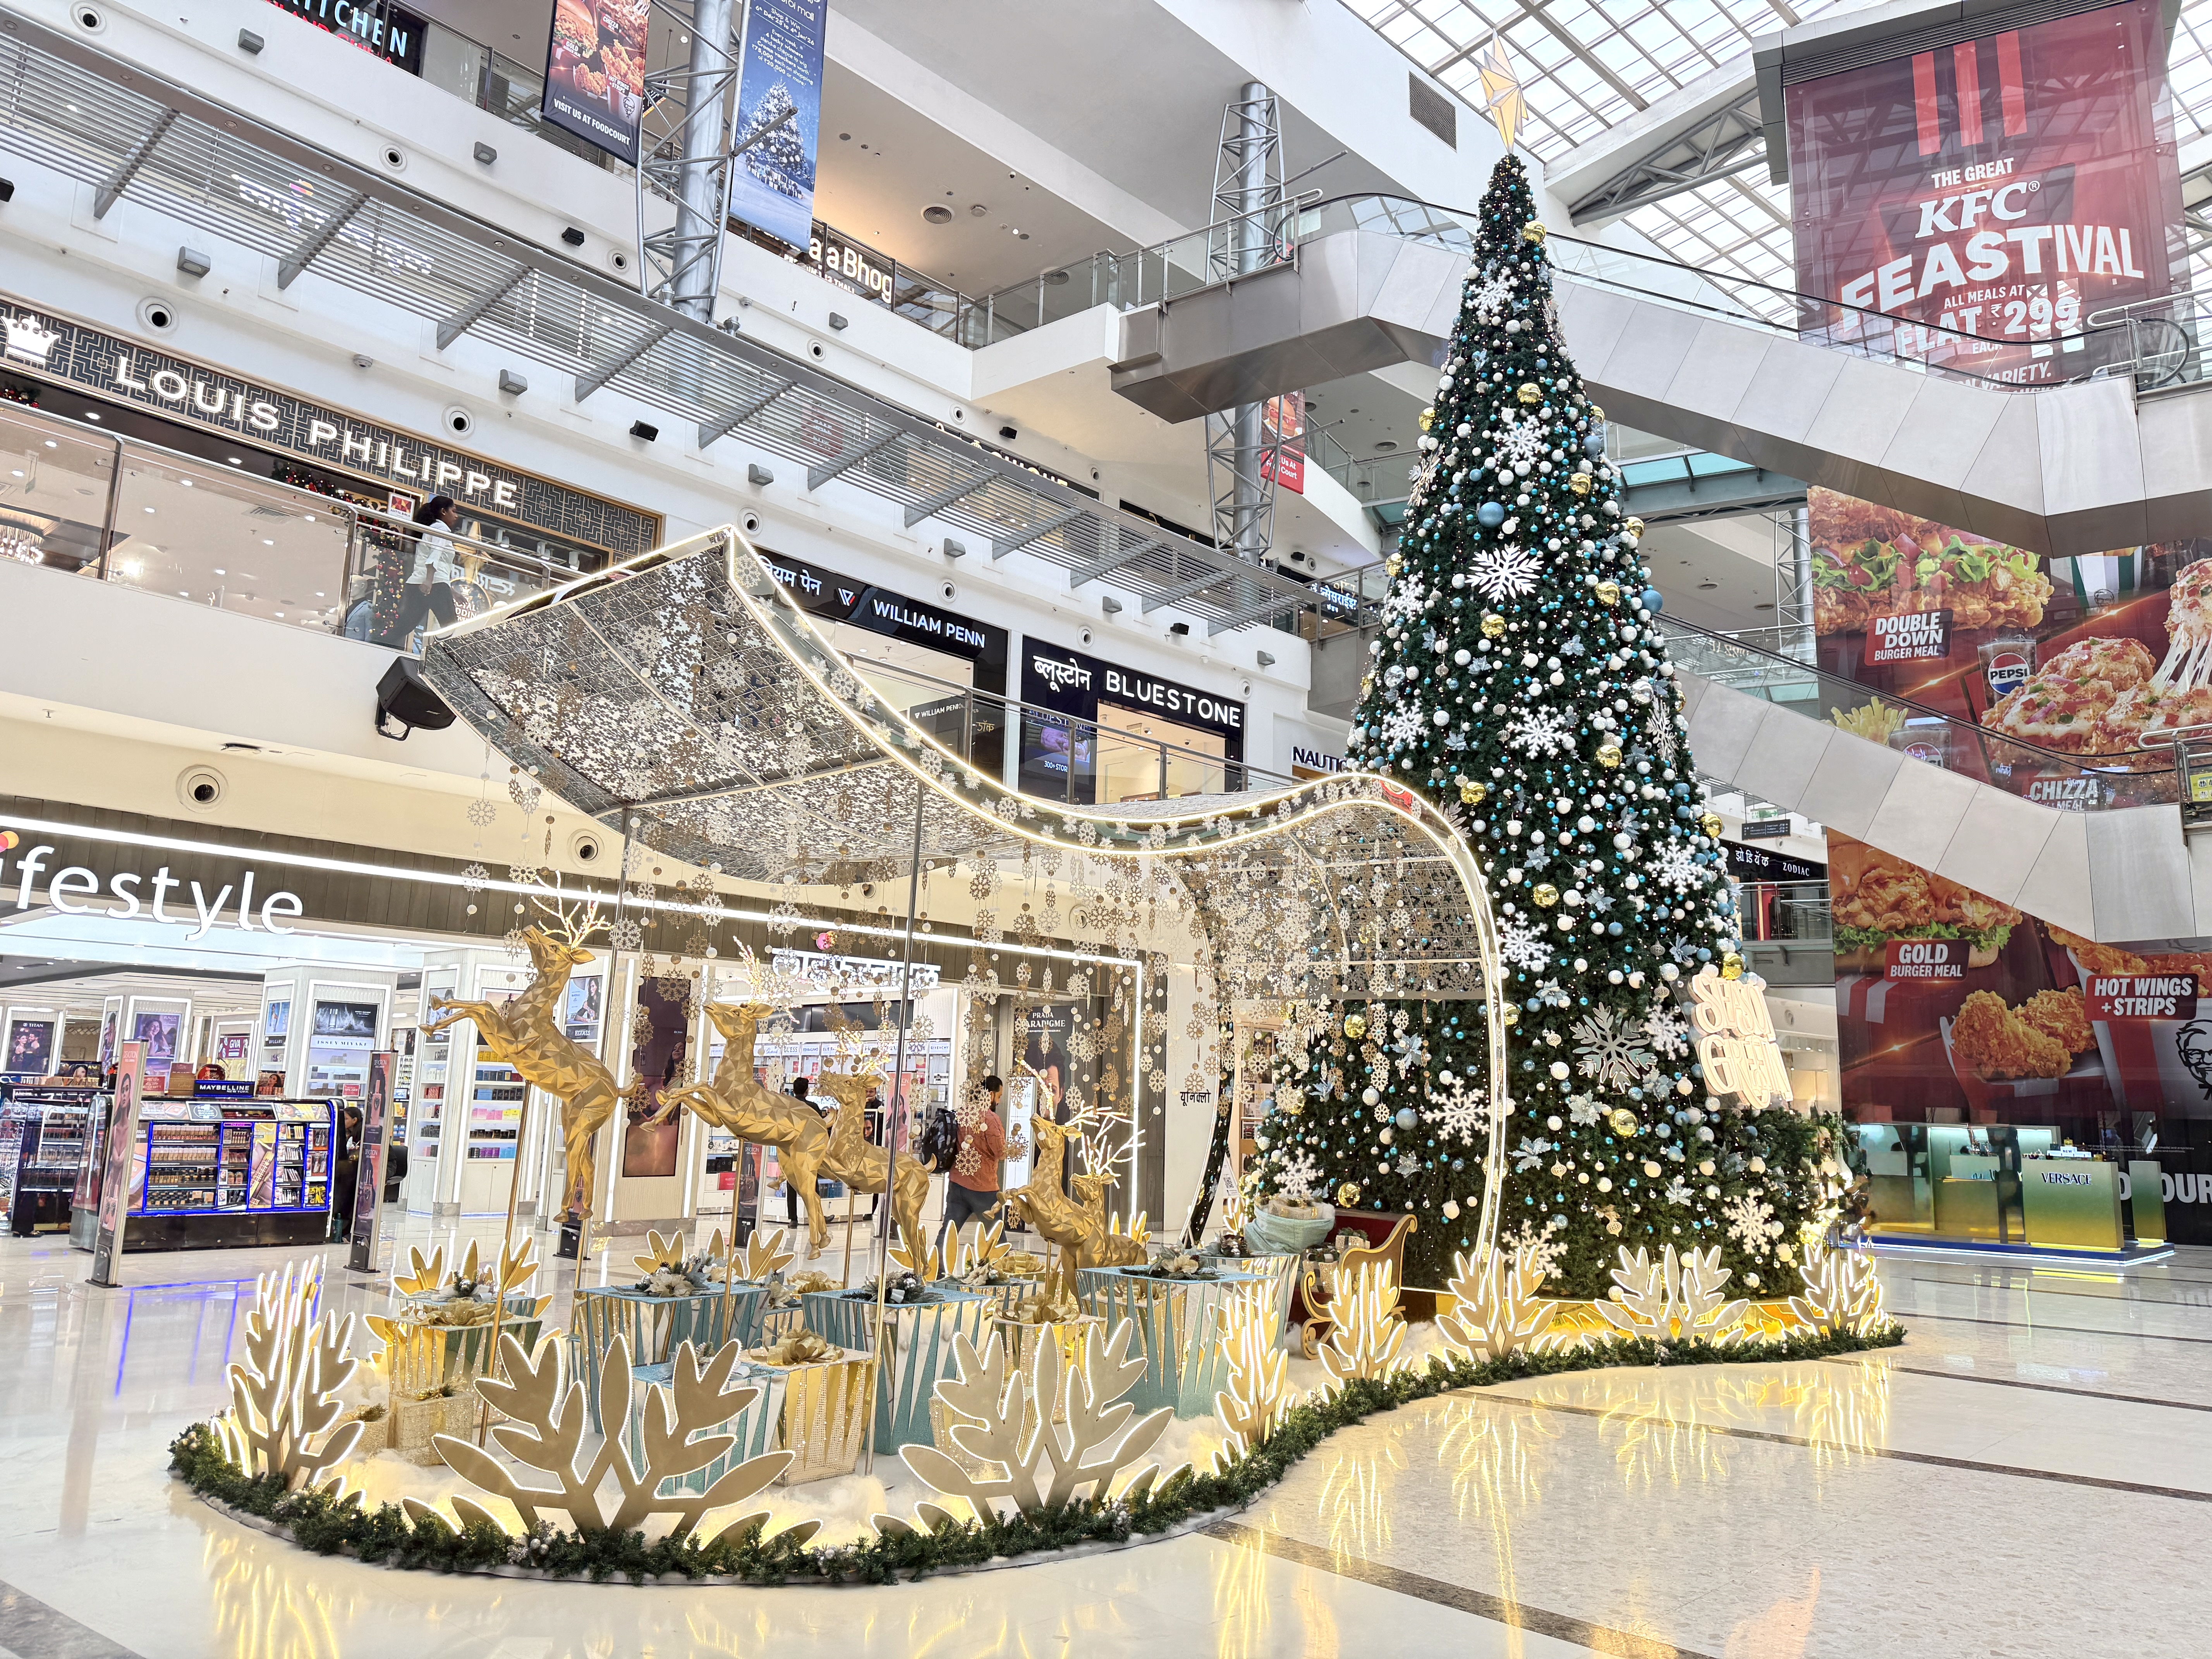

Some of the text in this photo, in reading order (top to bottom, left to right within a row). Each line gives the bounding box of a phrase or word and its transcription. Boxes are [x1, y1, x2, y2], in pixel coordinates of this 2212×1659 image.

[603, 16, 618, 29] CHIZZA
[771, 8, 784, 20] Shop
[790, 20, 801, 31] Win
[797, 5, 814, 21] mall
[772, 29, 784, 41] Every
[566, 41, 579, 52] GOLD
[760, 36, 773, 46] stand
[777, 47, 793, 59] chance
[771, 34, 783, 47] lucky
[785, 45, 803, 59] winners
[752, 44, 773, 60] ₹75,000
[775, 58, 785, 68] each
[793, 70, 814, 86] shopping
[757, 41, 809, 76] Croma vouchers worth
[764, 58, 786, 74] ₹20,000
[608, 75, 629, 91] HOT WINGS
[554, 98, 630, 146] VISIT US AT FOODCOURT
[1931, 157, 2014, 189] THE GREAT
[1841, 224, 2145, 334] FEASTIVAL
[1944, 284, 2025, 309] ALL MEALS AT
[1899, 306, 1978, 360] FLAT
[115, 355, 517, 509] LOUIS PHILIPPE
[1281, 457, 1297, 470] Us At
[1281, 466, 1297, 480] Court
[800, 568, 822, 596] पेन
[874, 599, 985, 648] WILLIAM PENN
[1875, 612, 1941, 635] DOUBLE
[1884, 629, 1943, 649] DOWN
[1874, 645, 1939, 661] BURGER MEAL
[1033, 655, 1092, 692] ब्लूस्टोन
[1990, 668, 2028, 680] PEPSI
[1106, 670, 1241, 728] BLUESTONE
[921, 707, 945, 718] WILLIAM
[1044, 760, 1055, 769] 300+
[2030, 779, 2098, 801] CHIZZA
[1783, 862, 1810, 876] ZODIAC
[1899, 944, 1948, 964] GOLD
[1890, 965, 1963, 977] BURGER MEAL
[2094, 977, 2193, 996] HOT WINGS
[229, 1039, 240, 1049] GIVA
[2041, 1171, 2092, 1185] VERSACE
